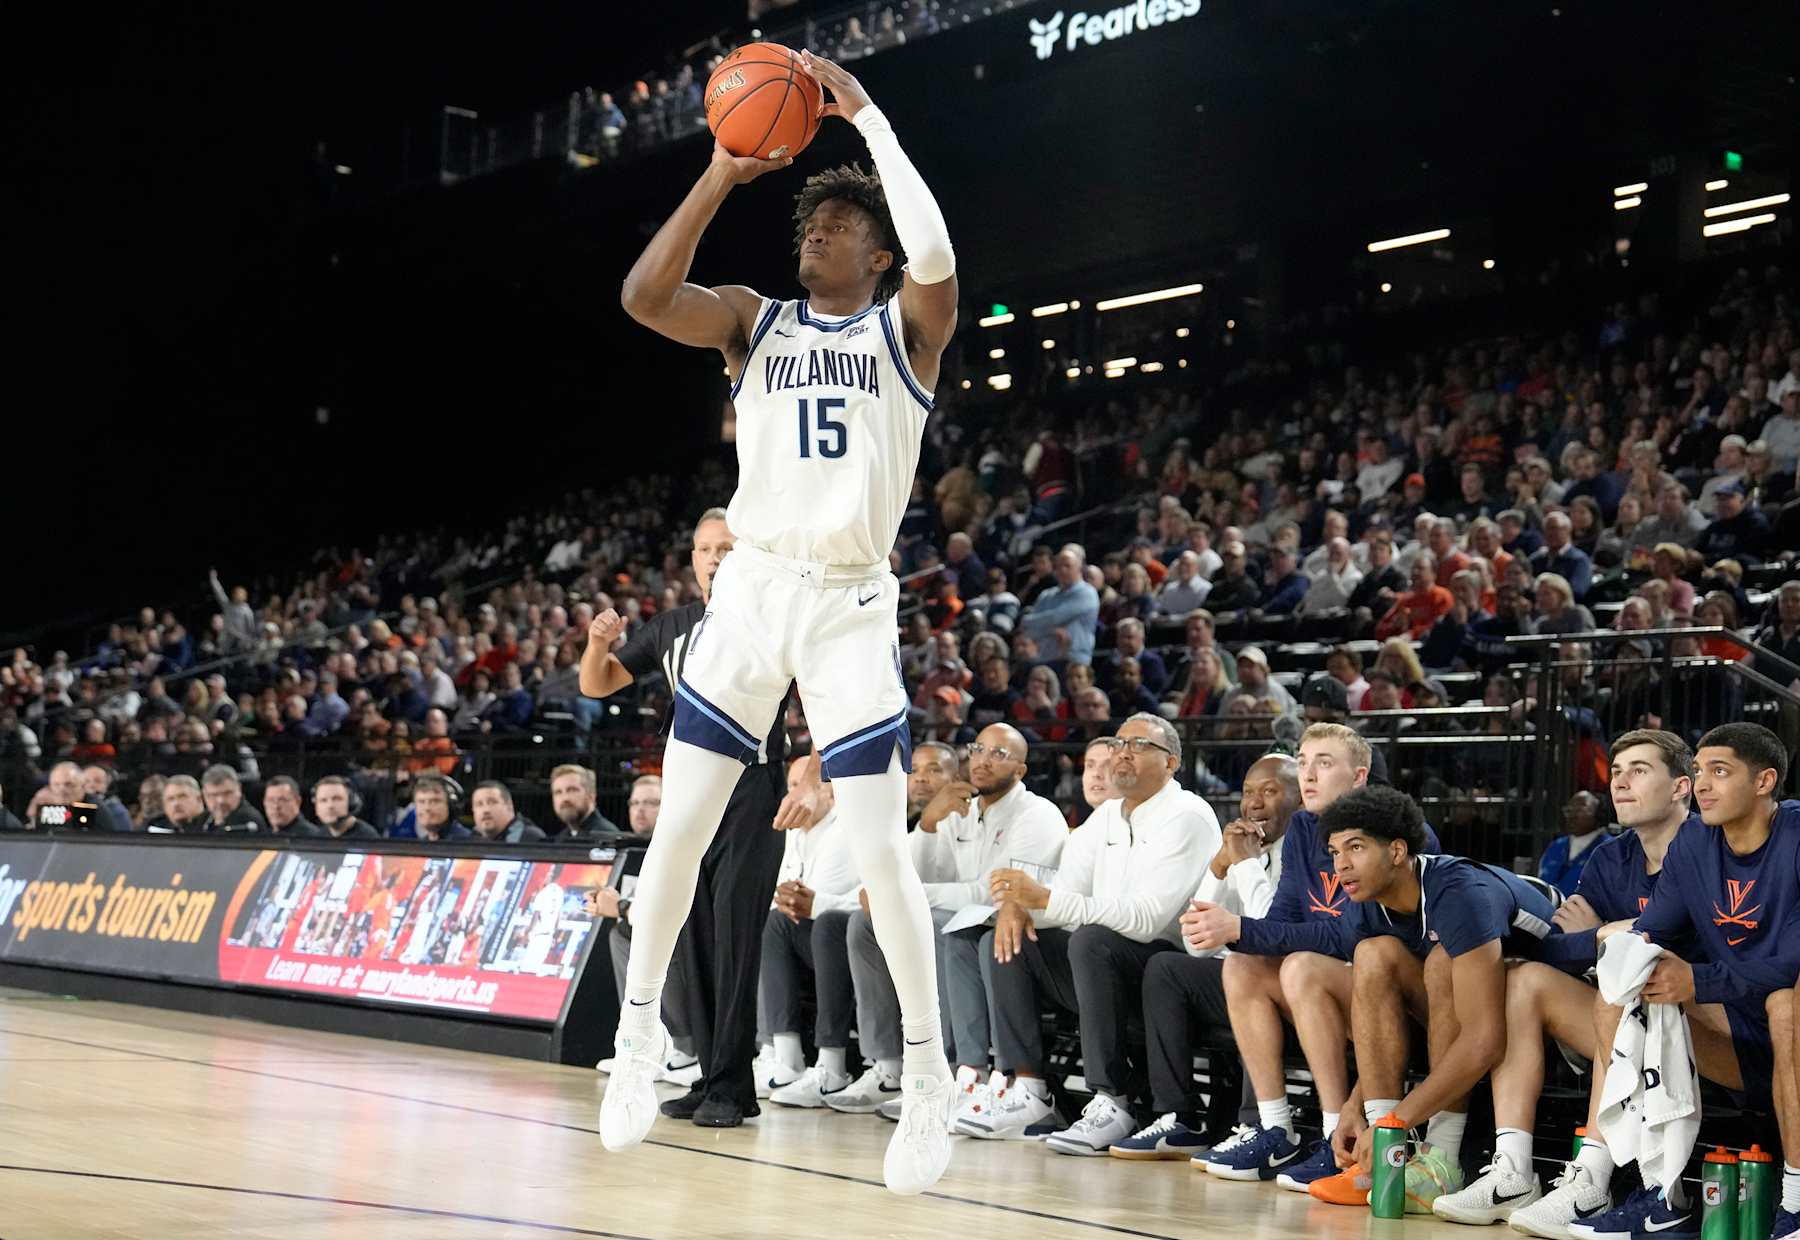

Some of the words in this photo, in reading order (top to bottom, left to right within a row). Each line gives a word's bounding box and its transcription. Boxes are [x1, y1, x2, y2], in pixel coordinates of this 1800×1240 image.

[765, 348, 880, 399] VILLANOVA
[798, 398, 848, 459] 15
[13, 872, 104, 942] sports
[96, 873, 216, 943] tourism
[265, 954, 307, 982] Learn
[303, 962, 342, 986] more
